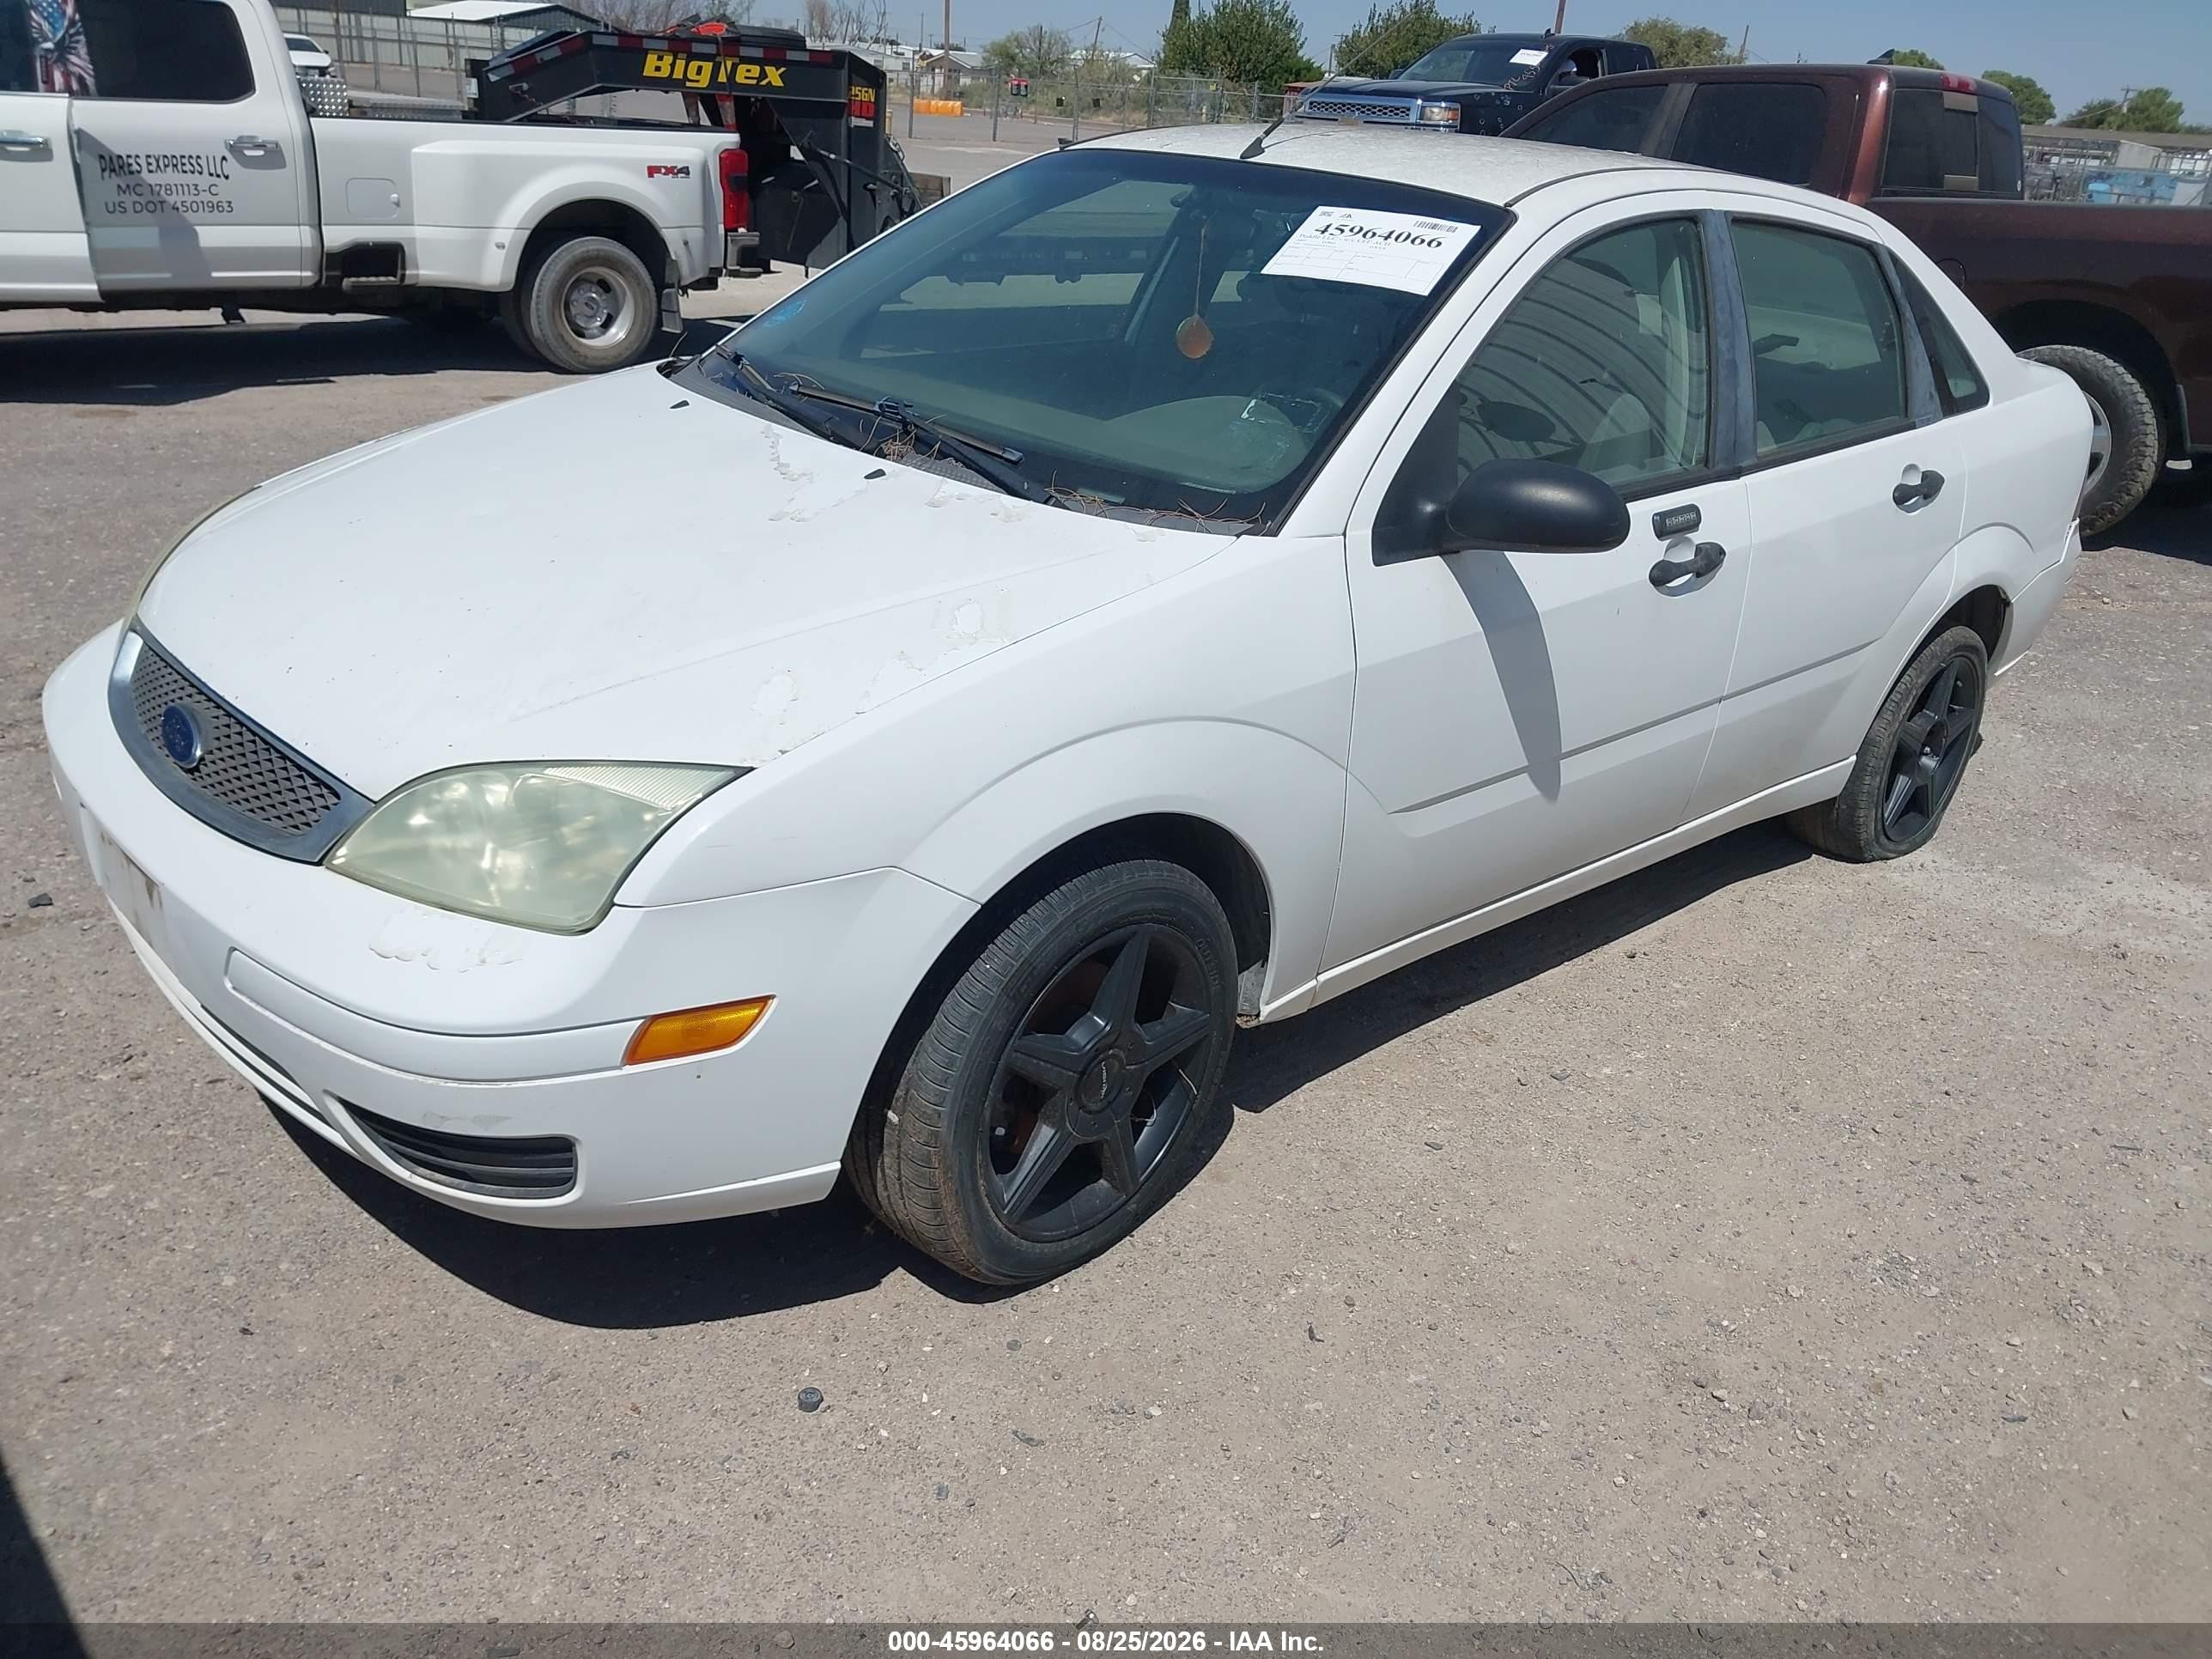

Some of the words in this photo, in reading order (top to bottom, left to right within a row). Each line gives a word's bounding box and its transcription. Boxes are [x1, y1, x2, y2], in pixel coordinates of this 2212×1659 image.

[98, 153, 143, 181] PARES
[145, 154, 204, 176] EXPRESS
[206, 155, 230, 181] LLC
[647, 165, 690, 179] FX4
[117, 183, 144, 197] MC
[149, 183, 220, 197] 1781113-C
[105, 200, 128, 214] US
[132, 200, 167, 214] DOT
[171, 200, 234, 214] 4501963
[1314, 222, 1447, 249] 45964066
